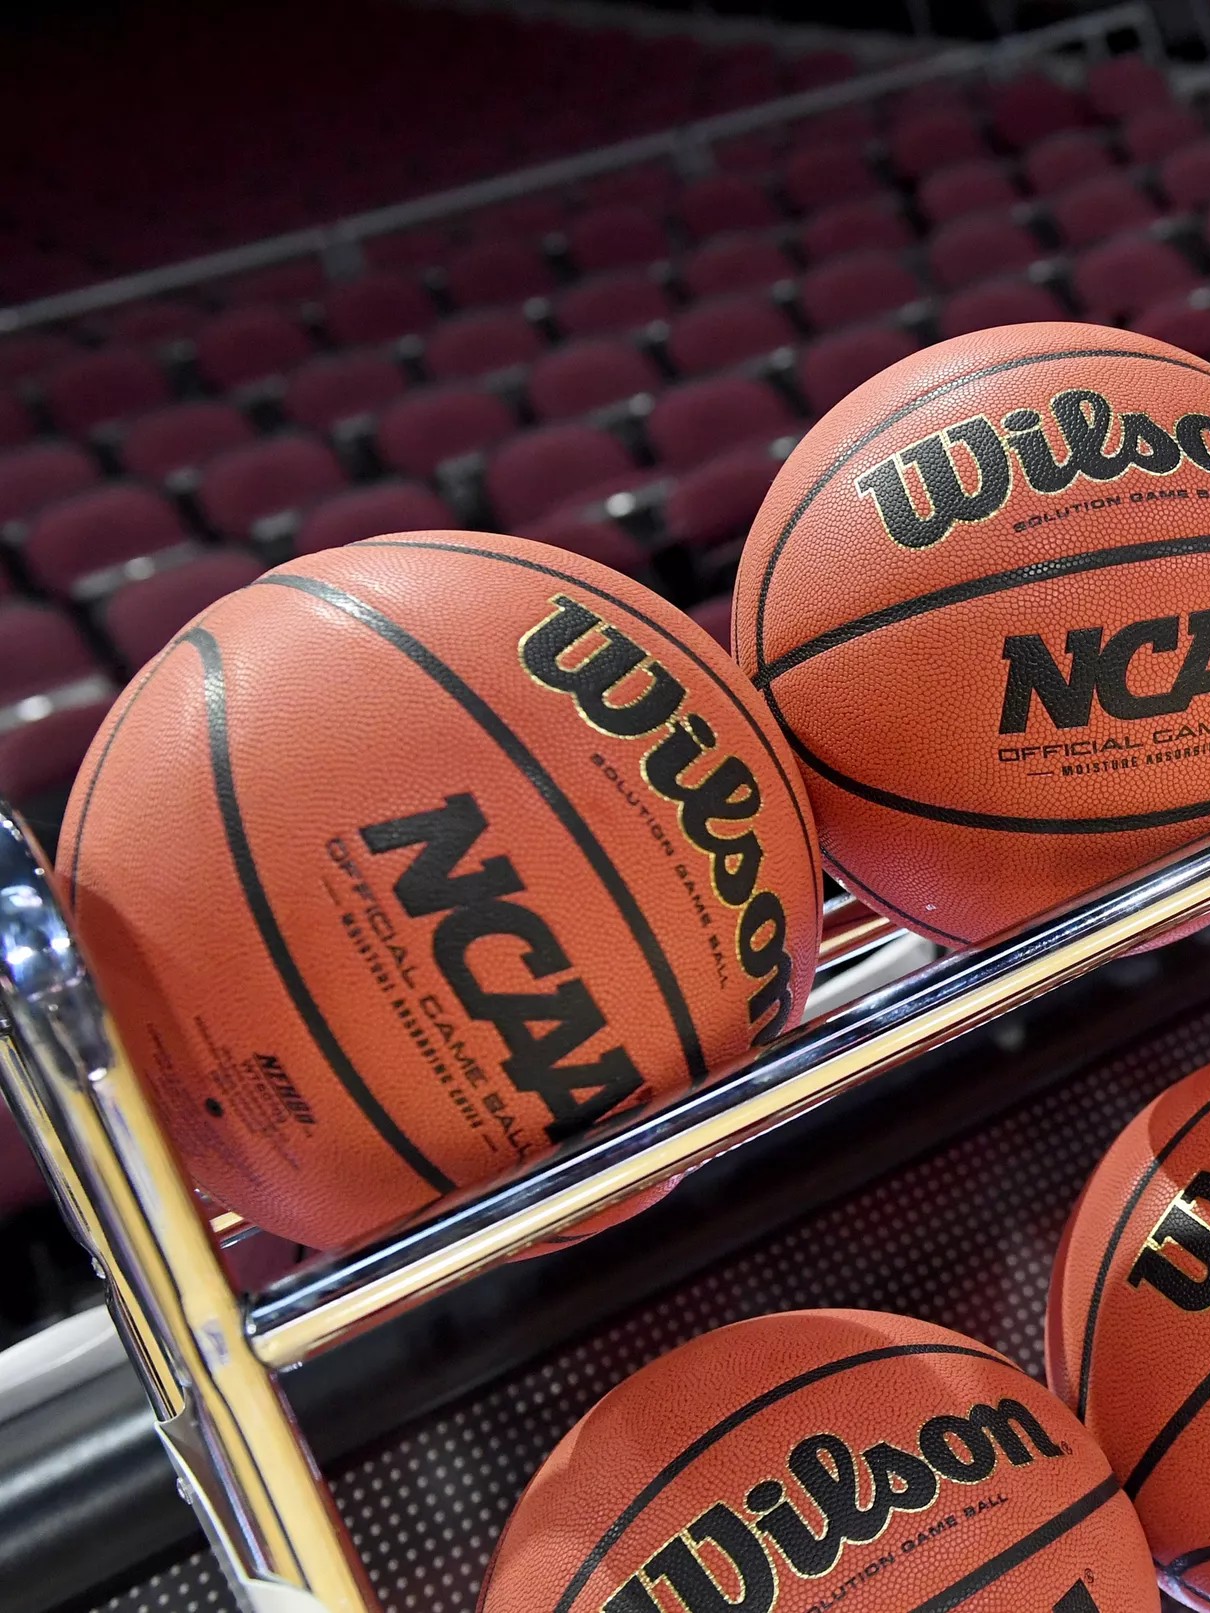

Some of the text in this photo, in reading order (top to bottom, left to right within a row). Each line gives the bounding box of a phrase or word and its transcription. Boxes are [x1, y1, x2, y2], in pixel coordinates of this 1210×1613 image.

[1012, 494, 1121, 533] SOLUTION
[1129, 489, 1190, 503] GAME
[517, 593, 794, 1050] Wilson
[998, 735, 1145, 763] OFFICIAL
[1061, 756, 1139, 777] MOISTURE
[326, 837, 417, 991] OFFICIAL
[419, 993, 488, 1090] GAME
[359, 792, 646, 1144] NCAA
[590, 753, 731, 990] SOLUTION GAME BALL
[600, 1395, 1066, 1613] Wilson
[804, 1492, 1009, 1613] OLUTION GAME BALL
